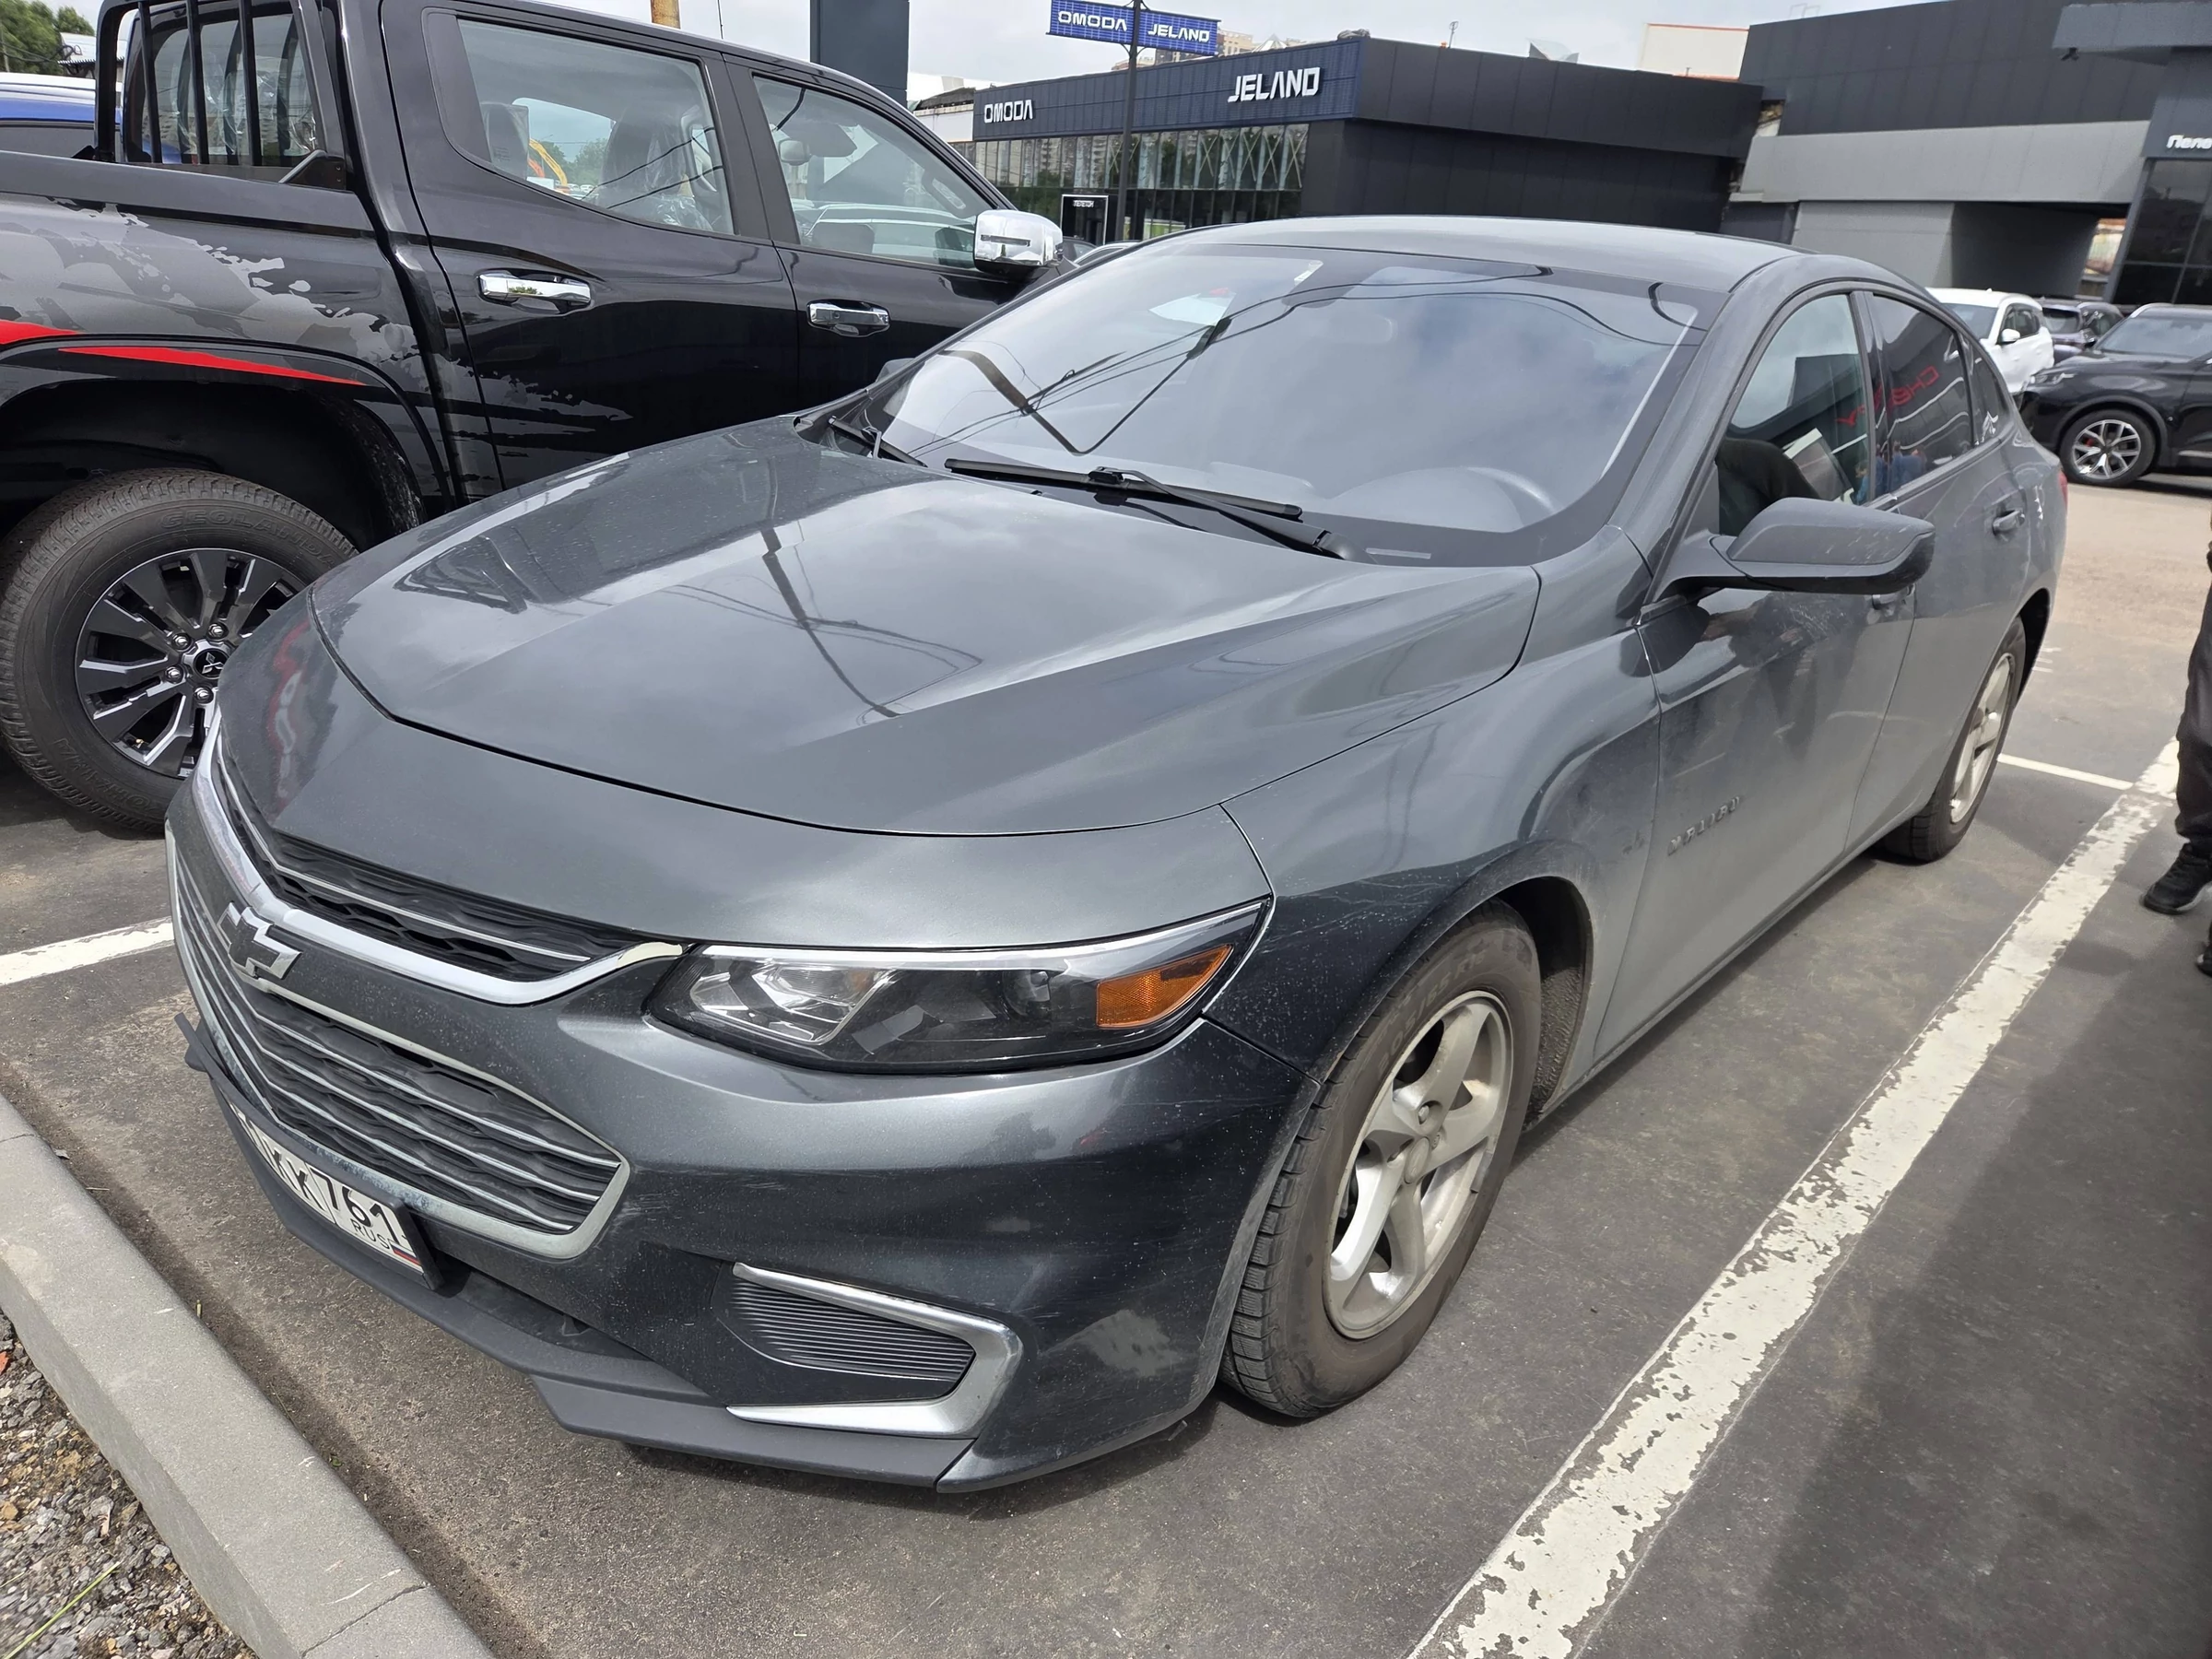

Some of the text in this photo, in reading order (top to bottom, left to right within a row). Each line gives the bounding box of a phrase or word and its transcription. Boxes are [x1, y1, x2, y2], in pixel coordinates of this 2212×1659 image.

[1057, 10, 1210, 42] OMODA JELAND
[1227, 66, 1321, 102] JELAND
[983, 99, 1033, 124] OMODA
[309, 1166, 400, 1245] 761
[350, 1218, 391, 1250] RUS
